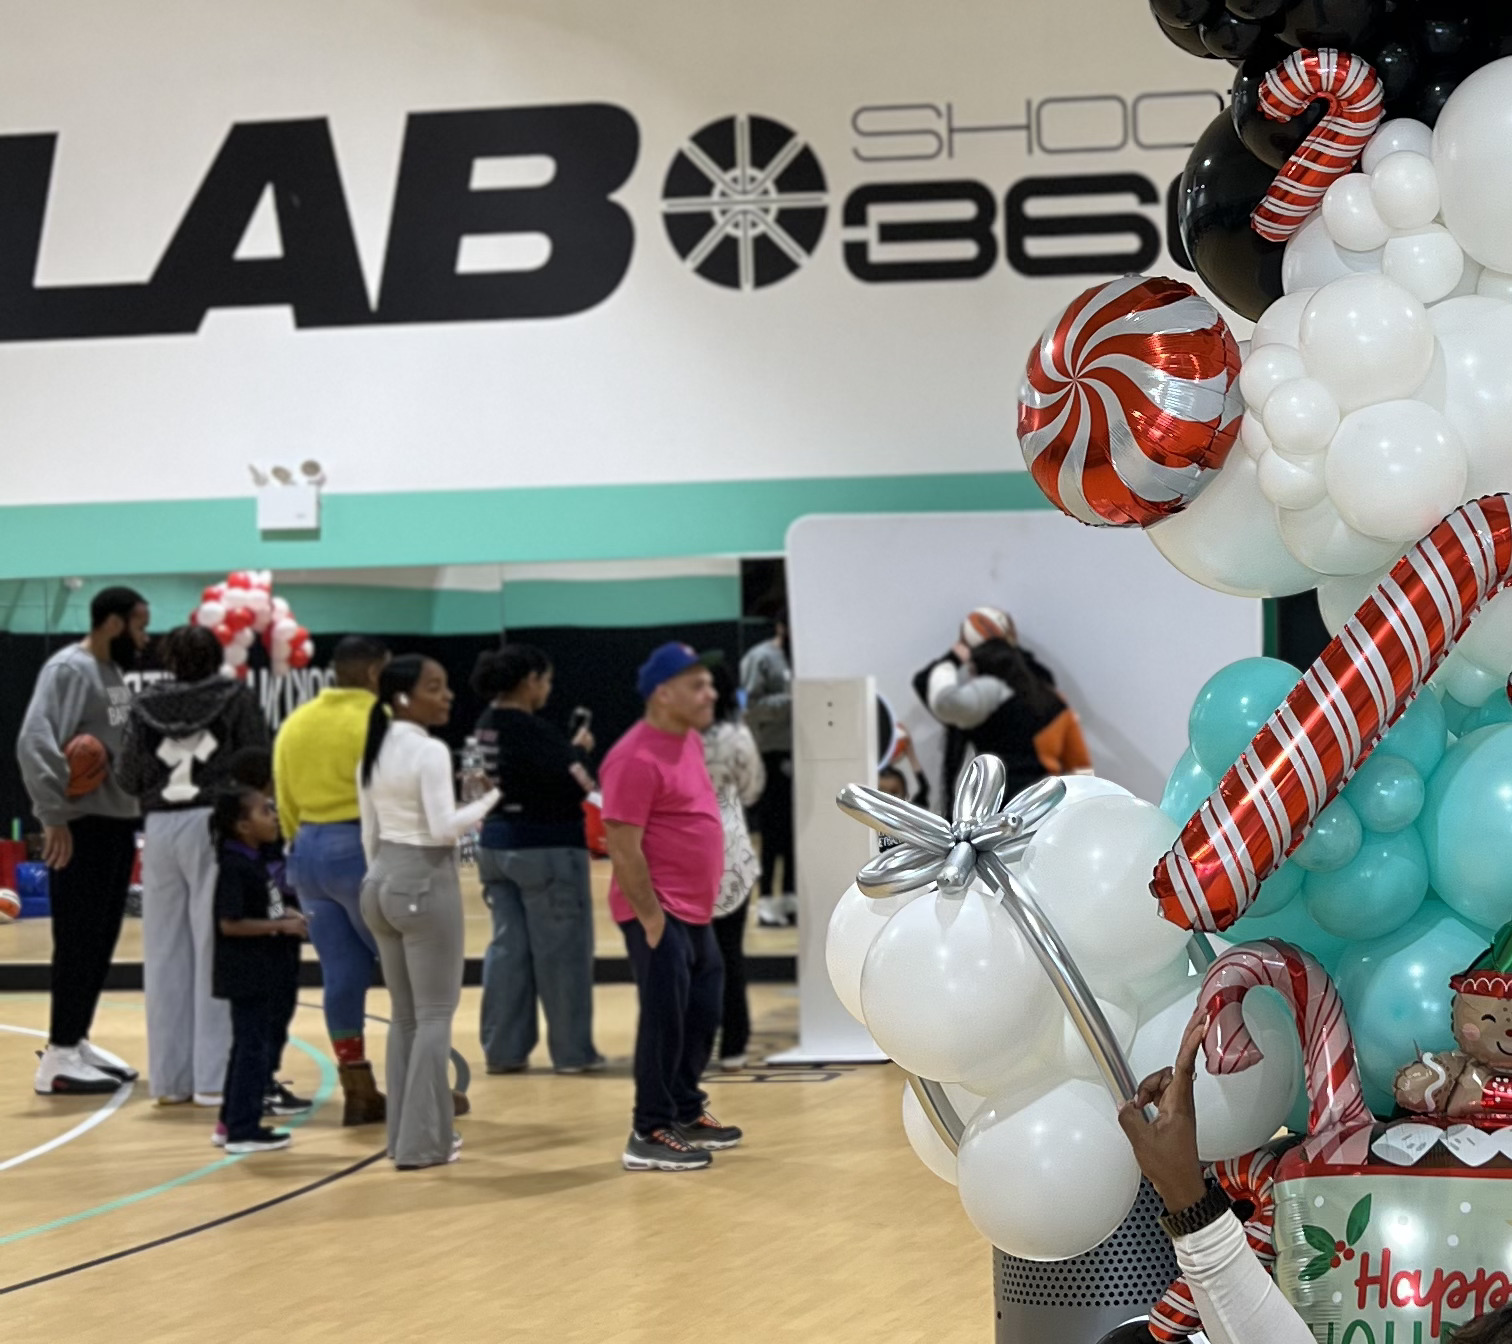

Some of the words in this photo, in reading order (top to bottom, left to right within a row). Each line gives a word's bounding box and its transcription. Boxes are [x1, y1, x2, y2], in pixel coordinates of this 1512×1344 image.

[852, 90, 1233, 163] SHOO
[0, 102, 642, 343] LAB
[842, 171, 1196, 283] 36
